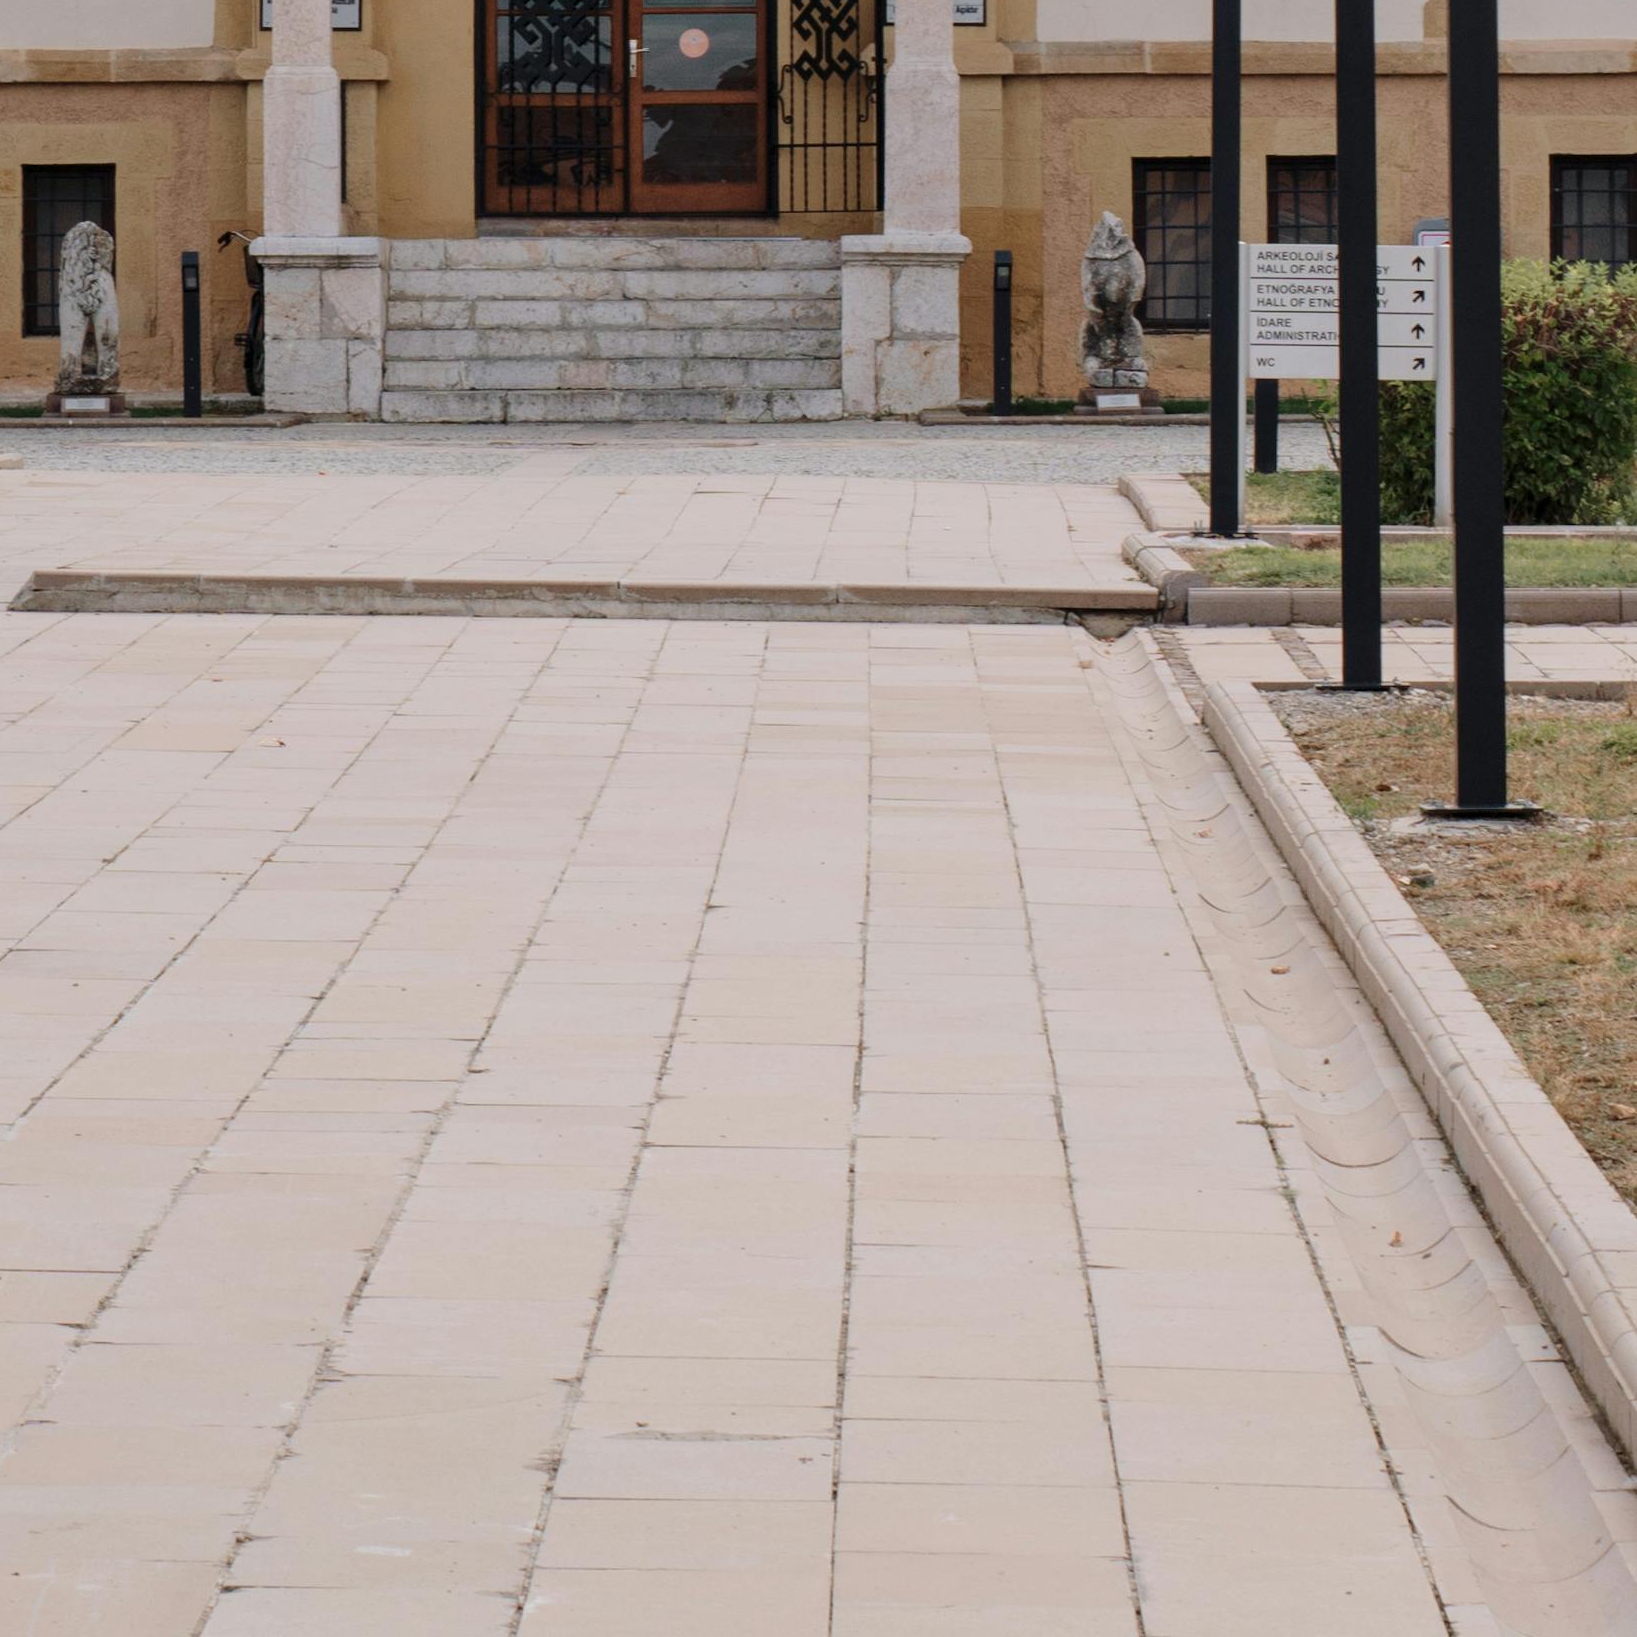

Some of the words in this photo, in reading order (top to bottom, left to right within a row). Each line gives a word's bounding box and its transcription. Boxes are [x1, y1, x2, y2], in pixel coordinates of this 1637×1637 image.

[1257, 250, 1324, 262] ARKEOLOJİ
[1257, 265, 1288, 274] HALL
[1290, 265, 1306, 274] OF
[1257, 283, 1335, 295] ETNOĞRAFYA
[1257, 298, 1287, 307] HALL
[1290, 298, 1306, 307] OF
[1257, 317, 1292, 328] İDARE
[1257, 331, 1340, 341] ADMINISTRATI
[1257, 357, 1275, 367] WC
